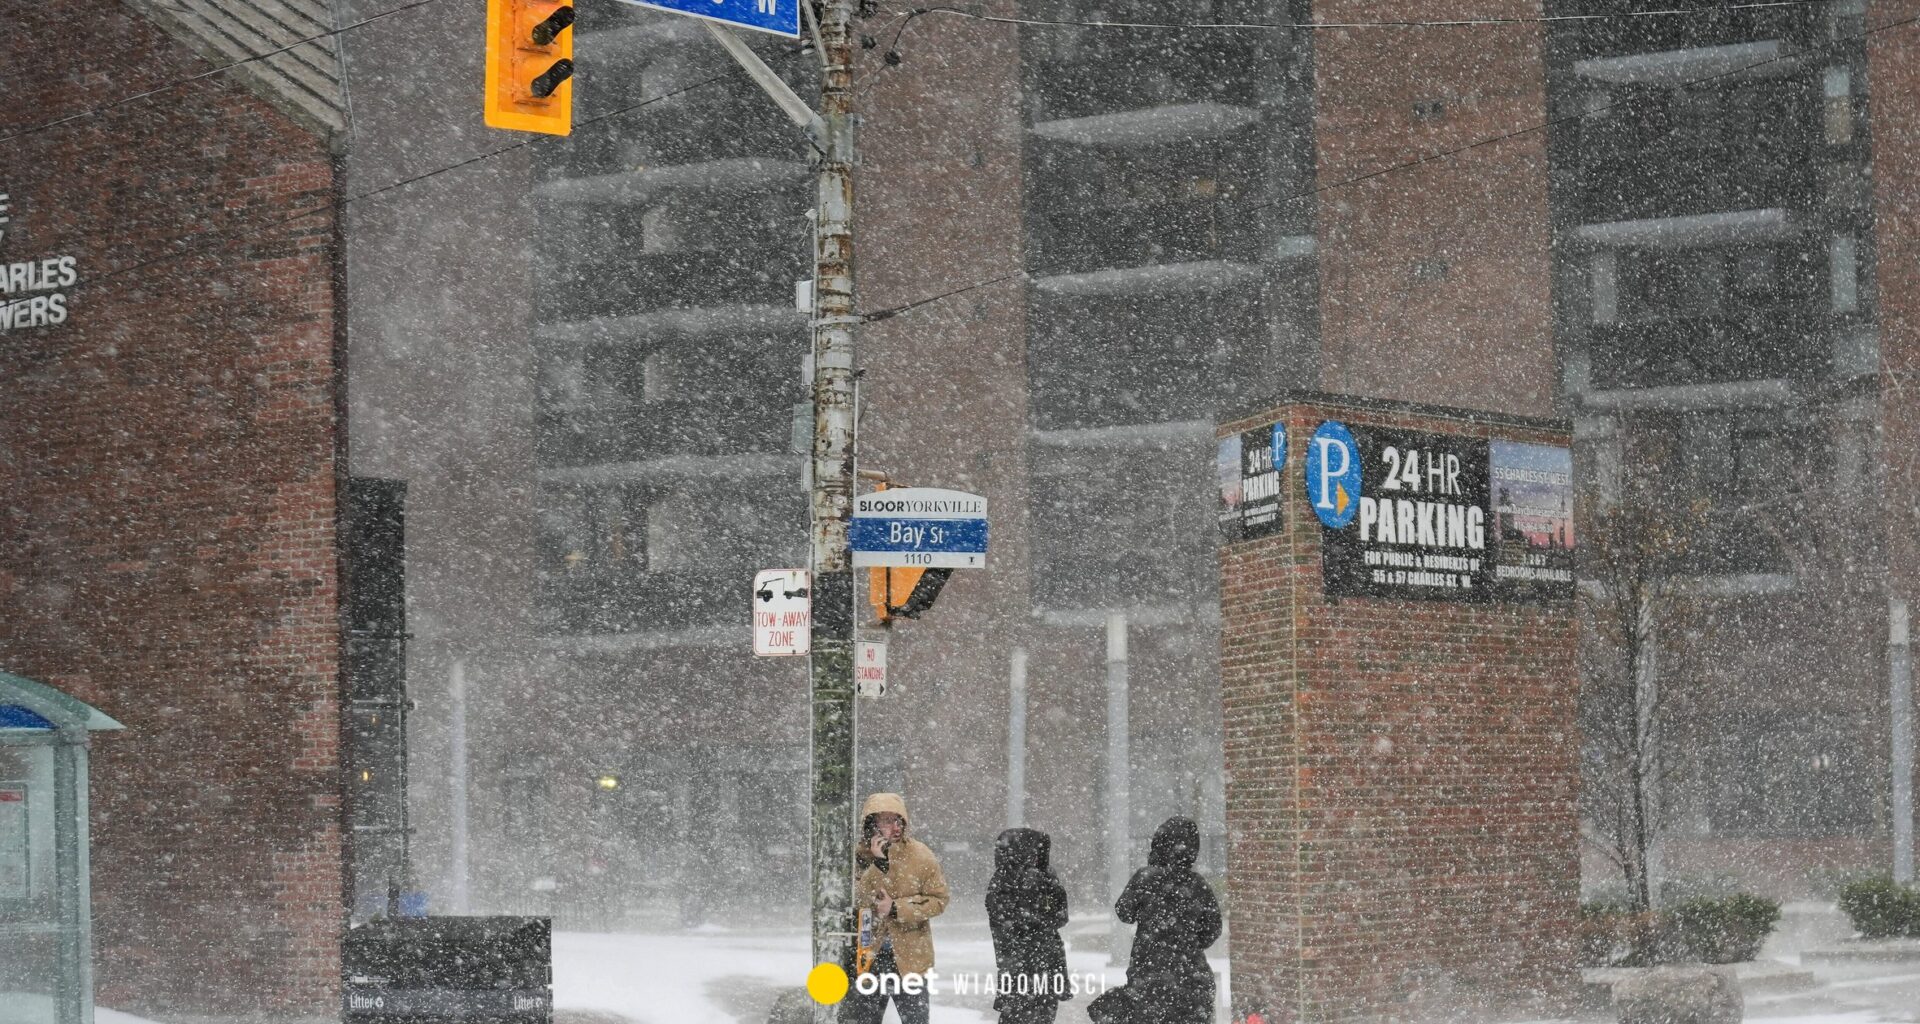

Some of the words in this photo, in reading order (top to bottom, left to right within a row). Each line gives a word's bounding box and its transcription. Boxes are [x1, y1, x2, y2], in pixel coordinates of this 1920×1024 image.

[1275, 431, 1284, 461] P
[1248, 449, 1260, 474] 24
[1316, 437, 1350, 509] P
[1382, 446, 1421, 491] 24
[1427, 451, 1461, 495] HR
[1505, 468, 1538, 483] CHARLES
[1243, 470, 1280, 502] PARKING
[1360, 496, 1485, 549] PARKING
[890, 522, 924, 548] Bay
[930, 526, 944, 544] St
[905, 553, 932, 564] 1110
[1364, 551, 1382, 565] FOR
[1383, 552, 1414, 567] PUBLIC
[1415, 556, 1422, 568] &
[1423, 555, 1469, 571] RESIDENTS
[1470, 558, 1480, 571] OF
[1373, 569, 1386, 583] 55
[1388, 573, 1394, 584] &
[1395, 571, 1406, 584] 57
[1407, 571, 1445, 586] CHARLES
[1496, 565, 1536, 579] BEDROOMS
[1536, 568, 1572, 582] AVAILABLE
[756, 611, 808, 627] TOW-AWAY
[768, 631, 794, 647] ZONE
[866, 648, 875, 661] NO
[857, 667, 885, 680] STANDING
[350, 994, 373, 1008] Litter
[514, 996, 534, 1010] Litter
